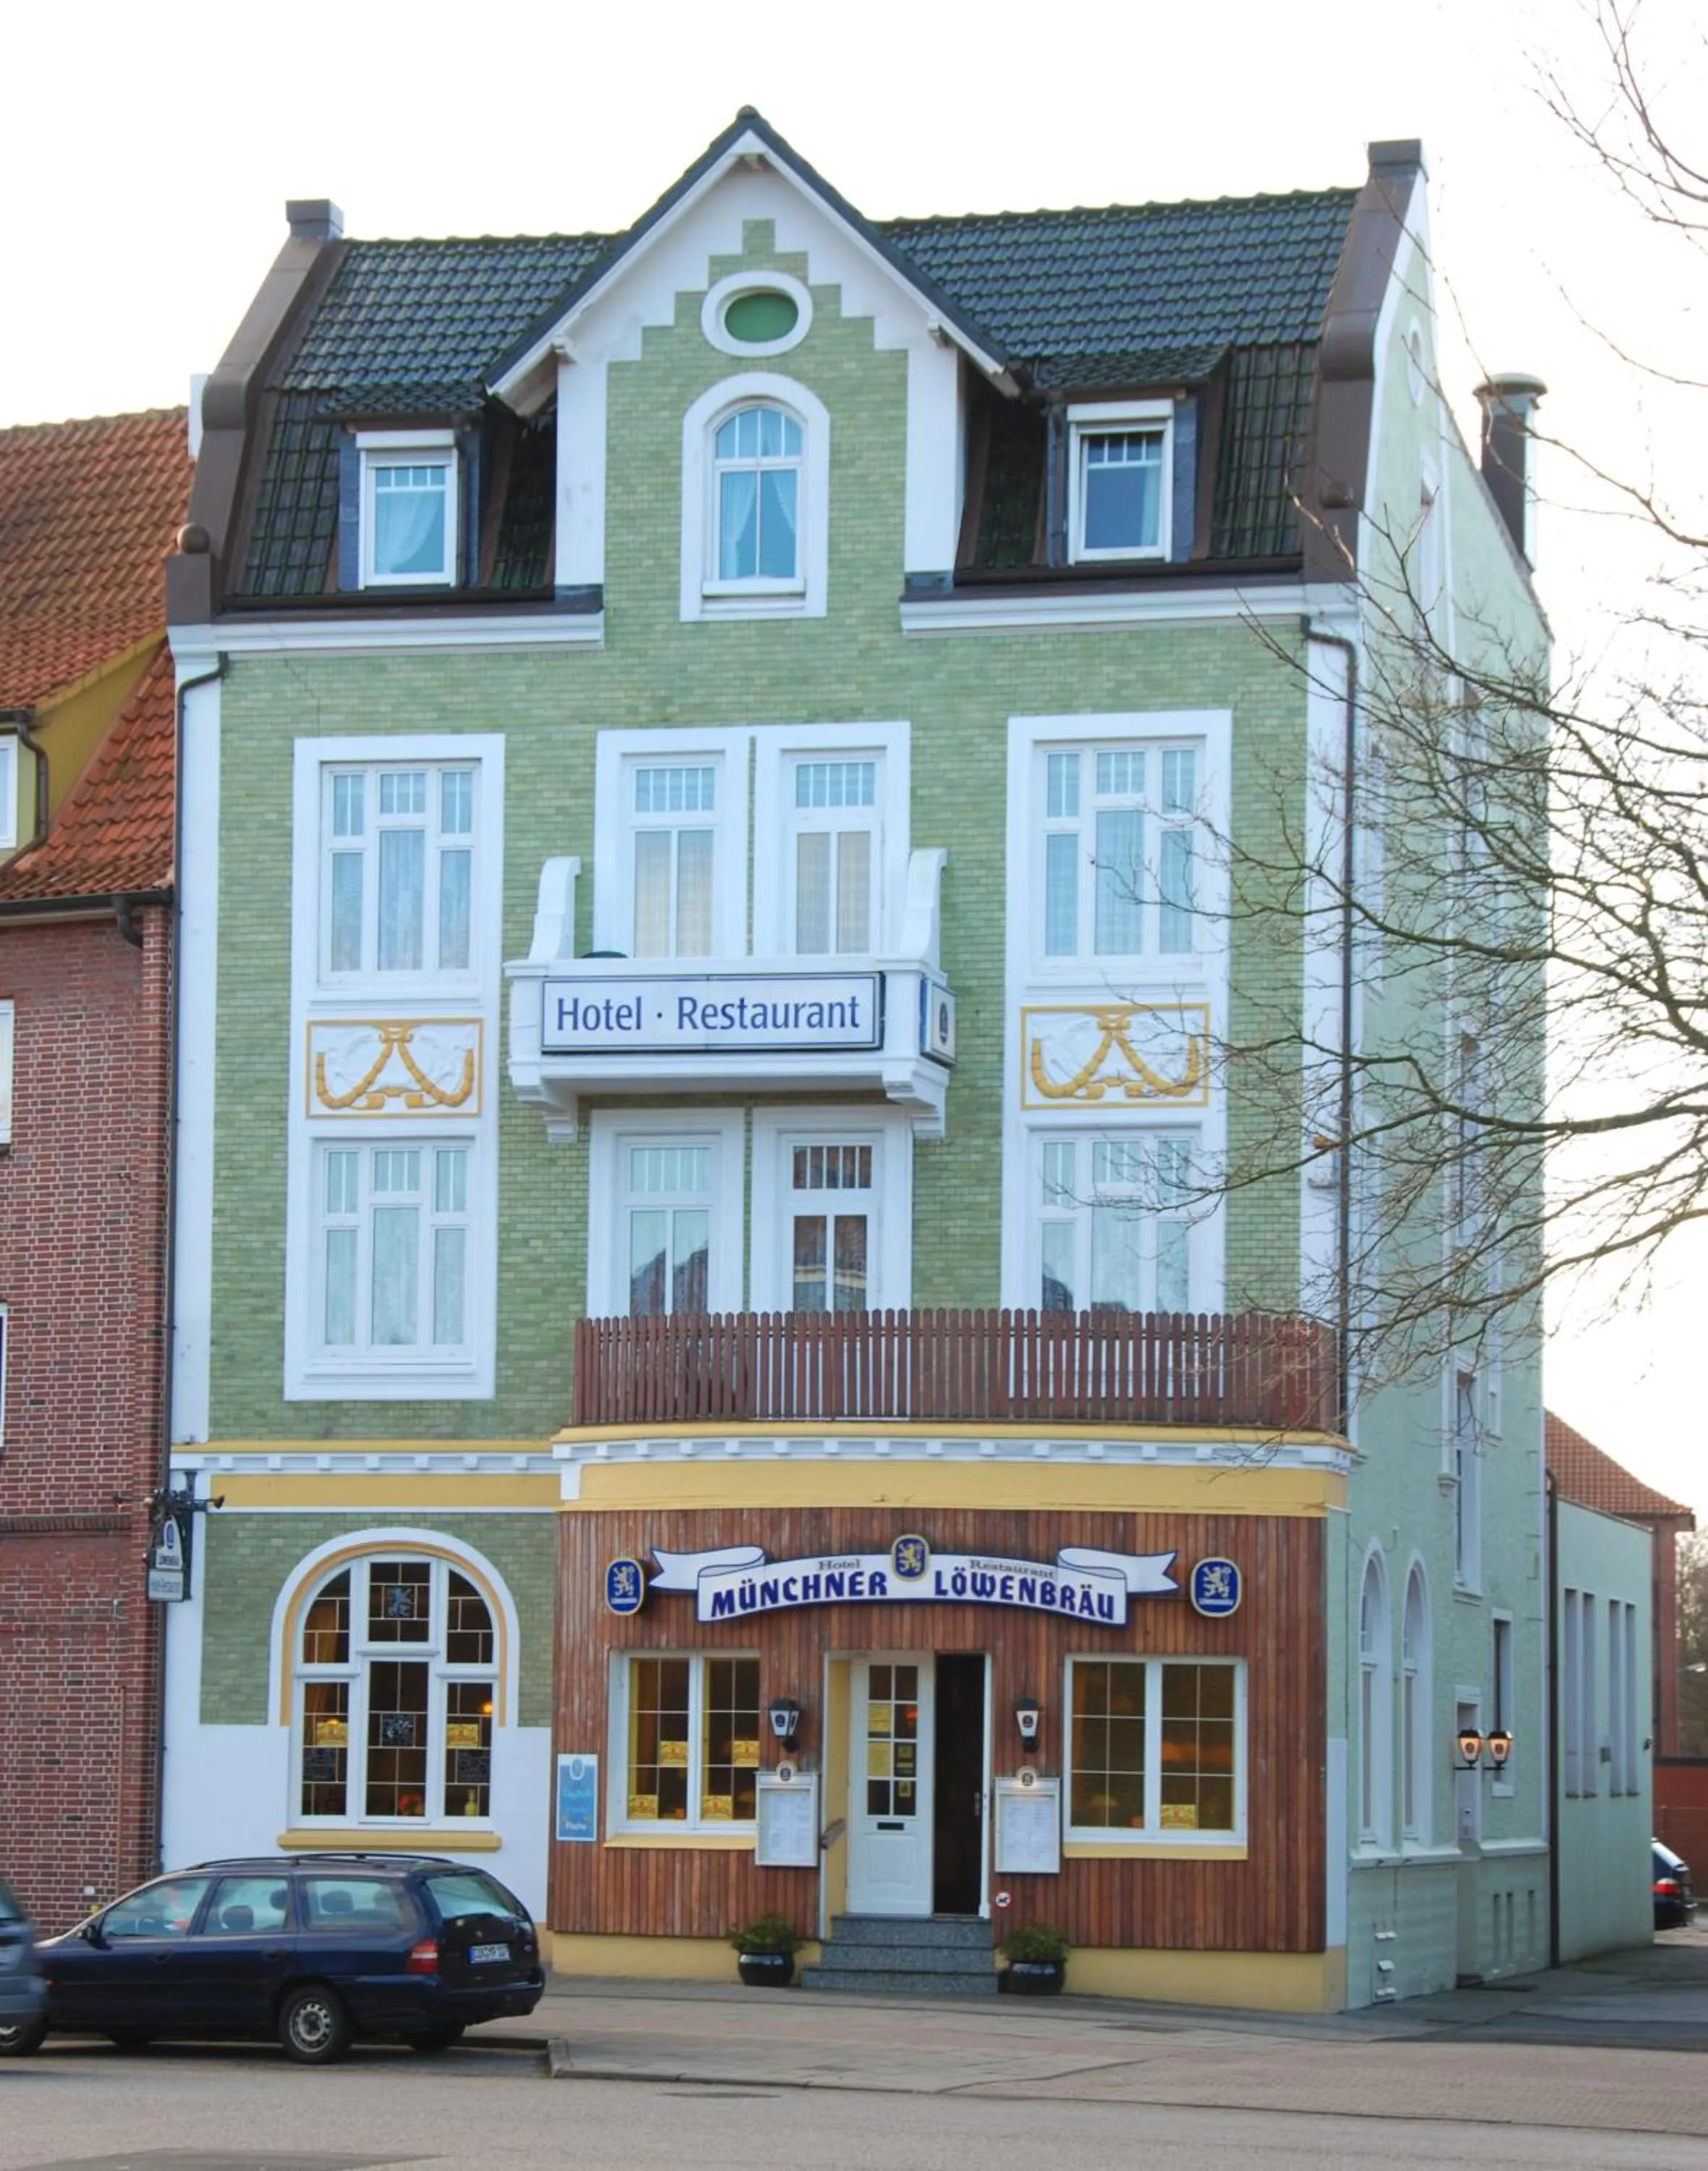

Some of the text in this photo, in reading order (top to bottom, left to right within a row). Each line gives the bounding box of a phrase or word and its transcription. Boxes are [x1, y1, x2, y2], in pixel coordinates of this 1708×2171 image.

[556, 995, 861, 1031] Hotel Restaurant
[818, 1558, 1054, 1578] Hotel Restaurant
[711, 1566, 1115, 1620] MÜNCHNER LÖWENBRÄU
